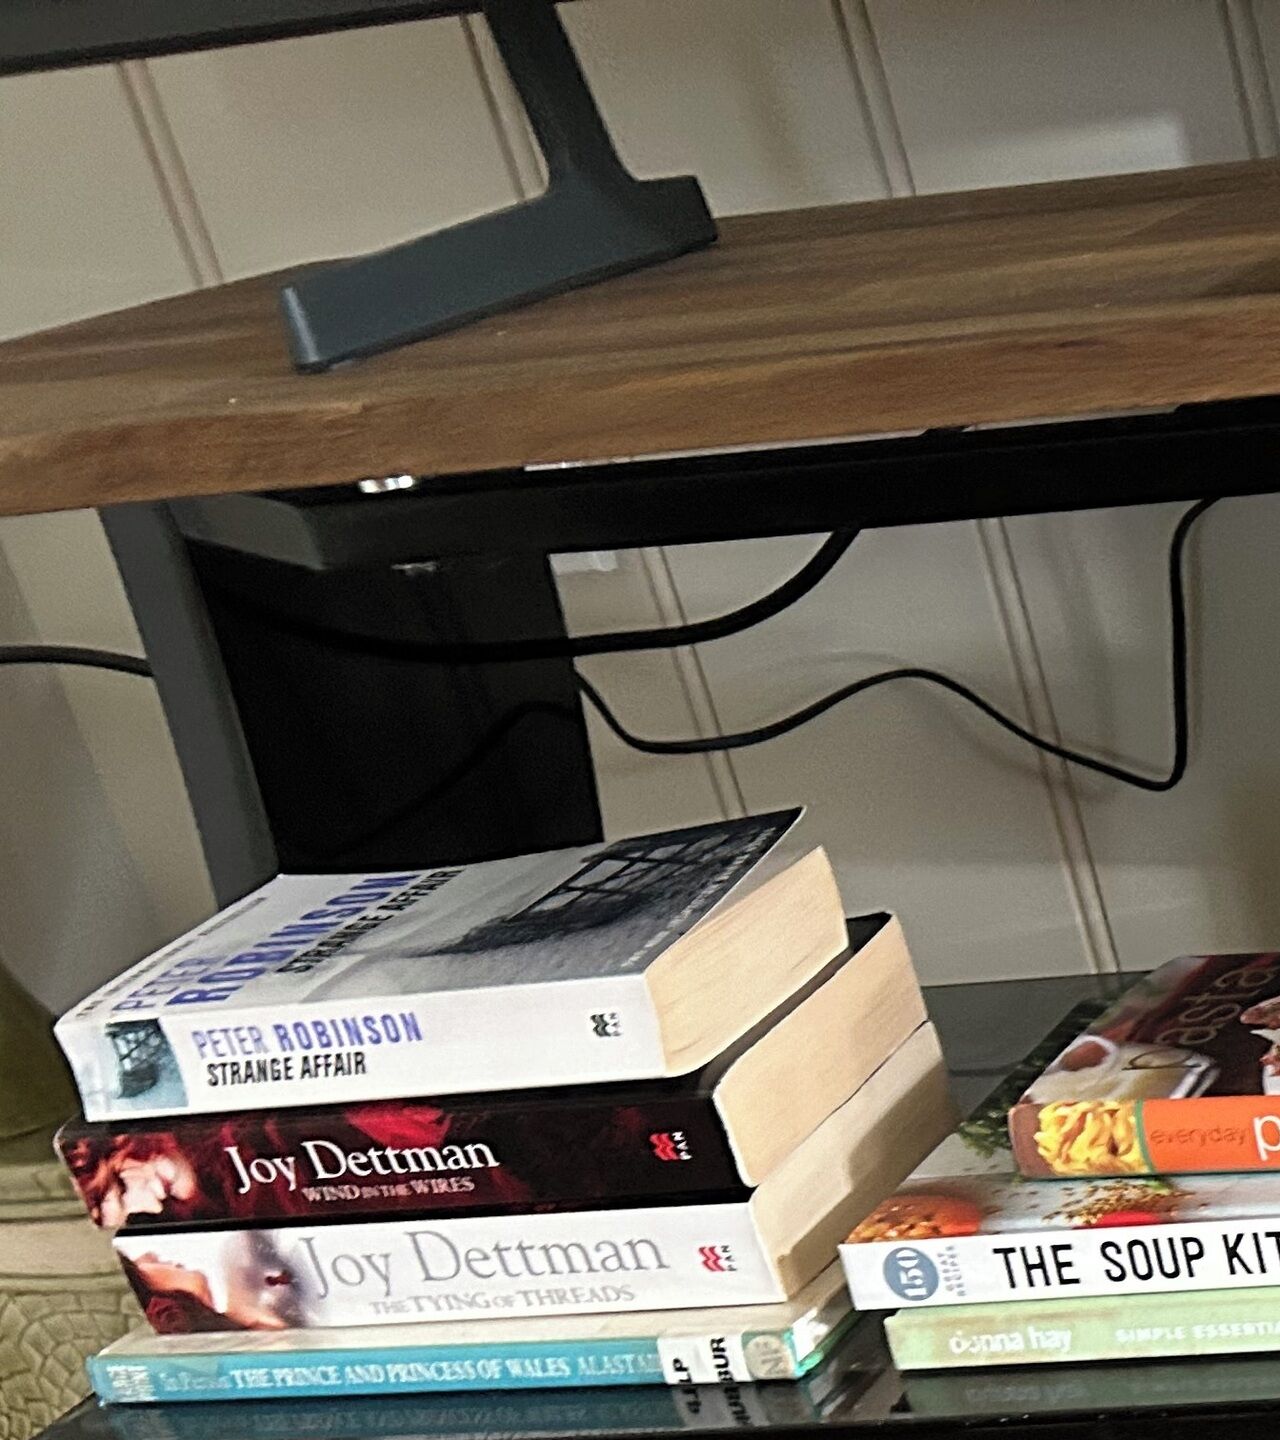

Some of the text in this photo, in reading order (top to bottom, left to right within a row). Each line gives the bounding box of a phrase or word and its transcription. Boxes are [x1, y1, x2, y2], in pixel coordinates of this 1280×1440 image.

[166, 874, 421, 1005] ROBINSON
[276, 914, 394, 974] STRANGE
[112, 956, 227, 1012] PETER
[191, 1012, 423, 1060] PETER ROBINSON
[207, 1051, 367, 1087] STRANGE AFFAIR
[1150, 1123, 1251, 1148] everyday
[224, 1140, 500, 1194] Joy Dettman
[302, 1183, 360, 1202] WIND
[379, 1182, 411, 1198] THE
[409, 1176, 475, 1195] WIRES
[299, 1230, 671, 1299] Joy Dettman
[895, 1249, 929, 1297] 150
[993, 1243, 1081, 1289] THE
[1100, 1235, 1205, 1282] SOUP
[369, 1300, 410, 1316] THE
[408, 1291, 491, 1313] TYING
[516, 1284, 636, 1307] THREADS
[949, 1325, 1073, 1354] donna hay
[1114, 1326, 1187, 1343] SIMPLE
[229, 1368, 273, 1389] THE
[272, 1365, 342, 1387] PRINCE
[344, 1362, 385, 1385] AND
[386, 1359, 478, 1384] PRINCESS
[477, 1358, 501, 1380] OF
[505, 1355, 572, 1378] WALES
